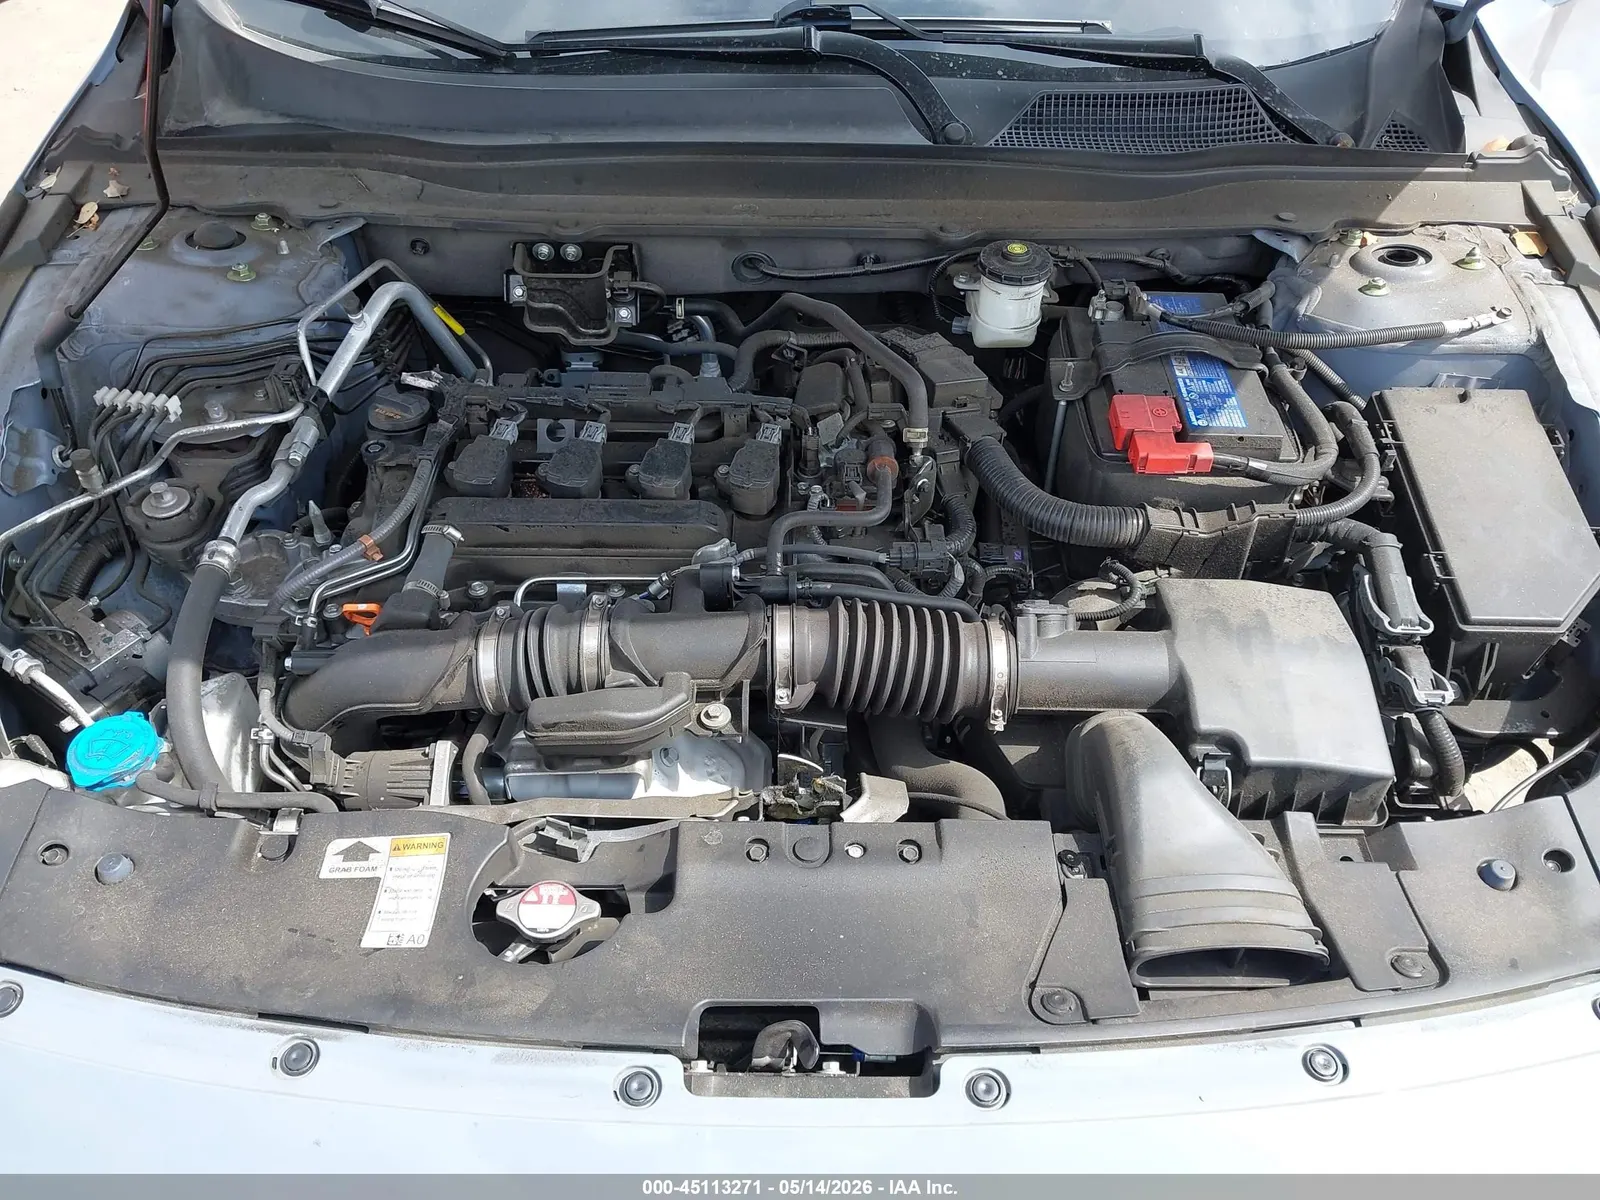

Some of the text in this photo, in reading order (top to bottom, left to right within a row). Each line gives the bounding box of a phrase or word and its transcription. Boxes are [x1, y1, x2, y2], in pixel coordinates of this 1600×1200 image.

[402, 841, 444, 851] WARNING
[328, 865, 378, 874] GRAB FOAM
